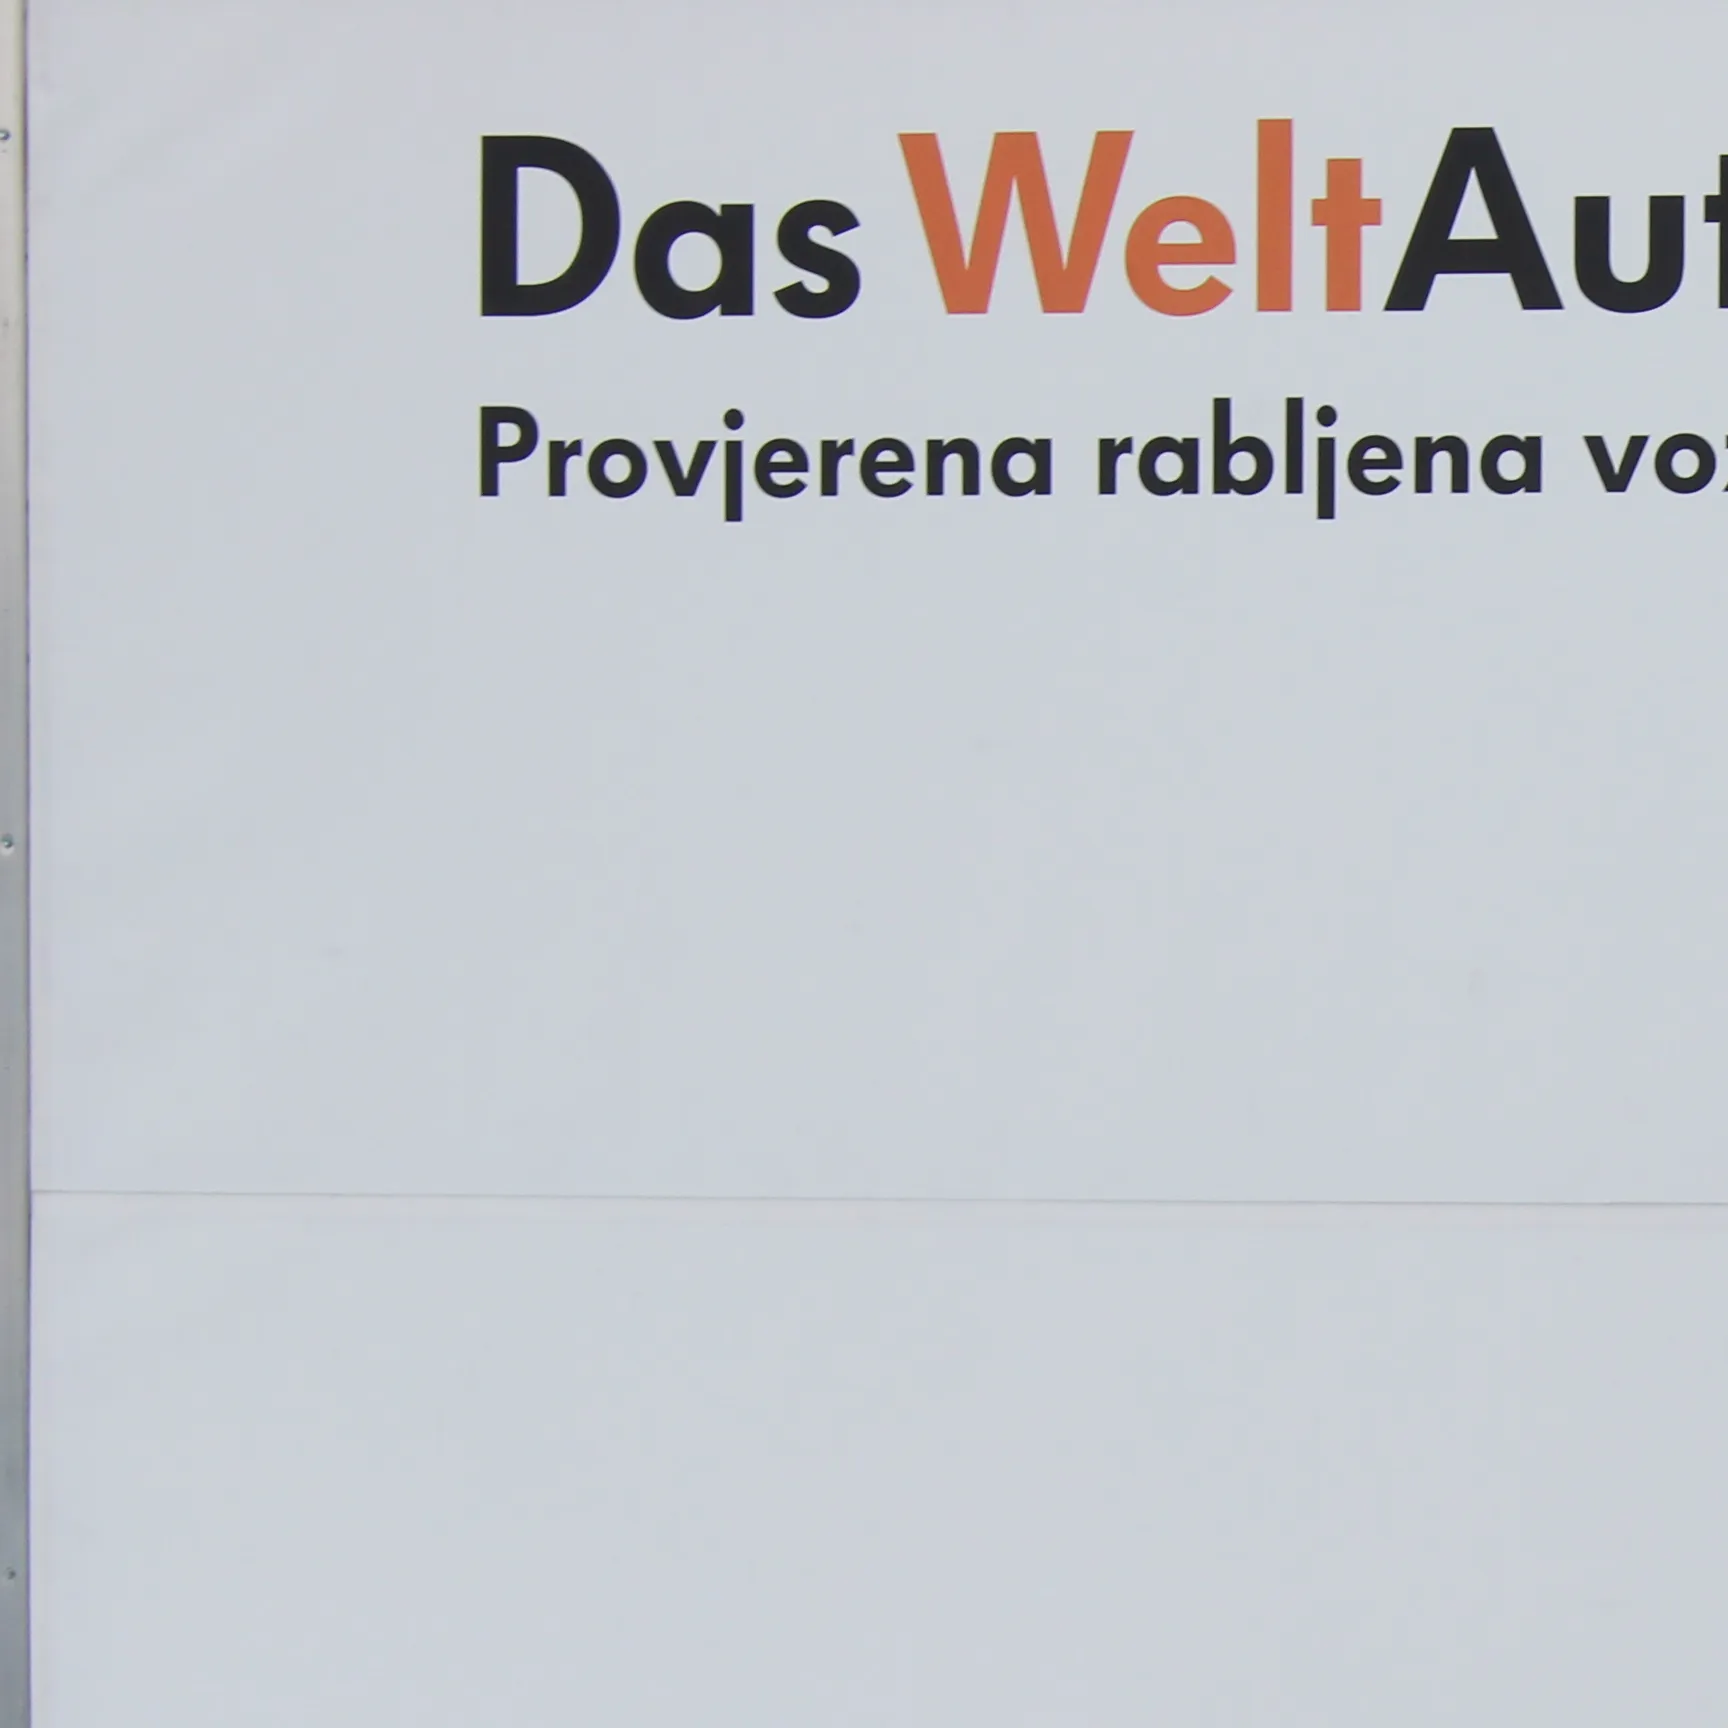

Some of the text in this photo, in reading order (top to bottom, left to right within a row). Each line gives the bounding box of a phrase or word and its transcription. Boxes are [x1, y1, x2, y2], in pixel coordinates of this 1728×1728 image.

[482, 134, 861, 319] Das
[480, 406, 1052, 523] Provjerena
[1098, 397, 1542, 520] rabljena
